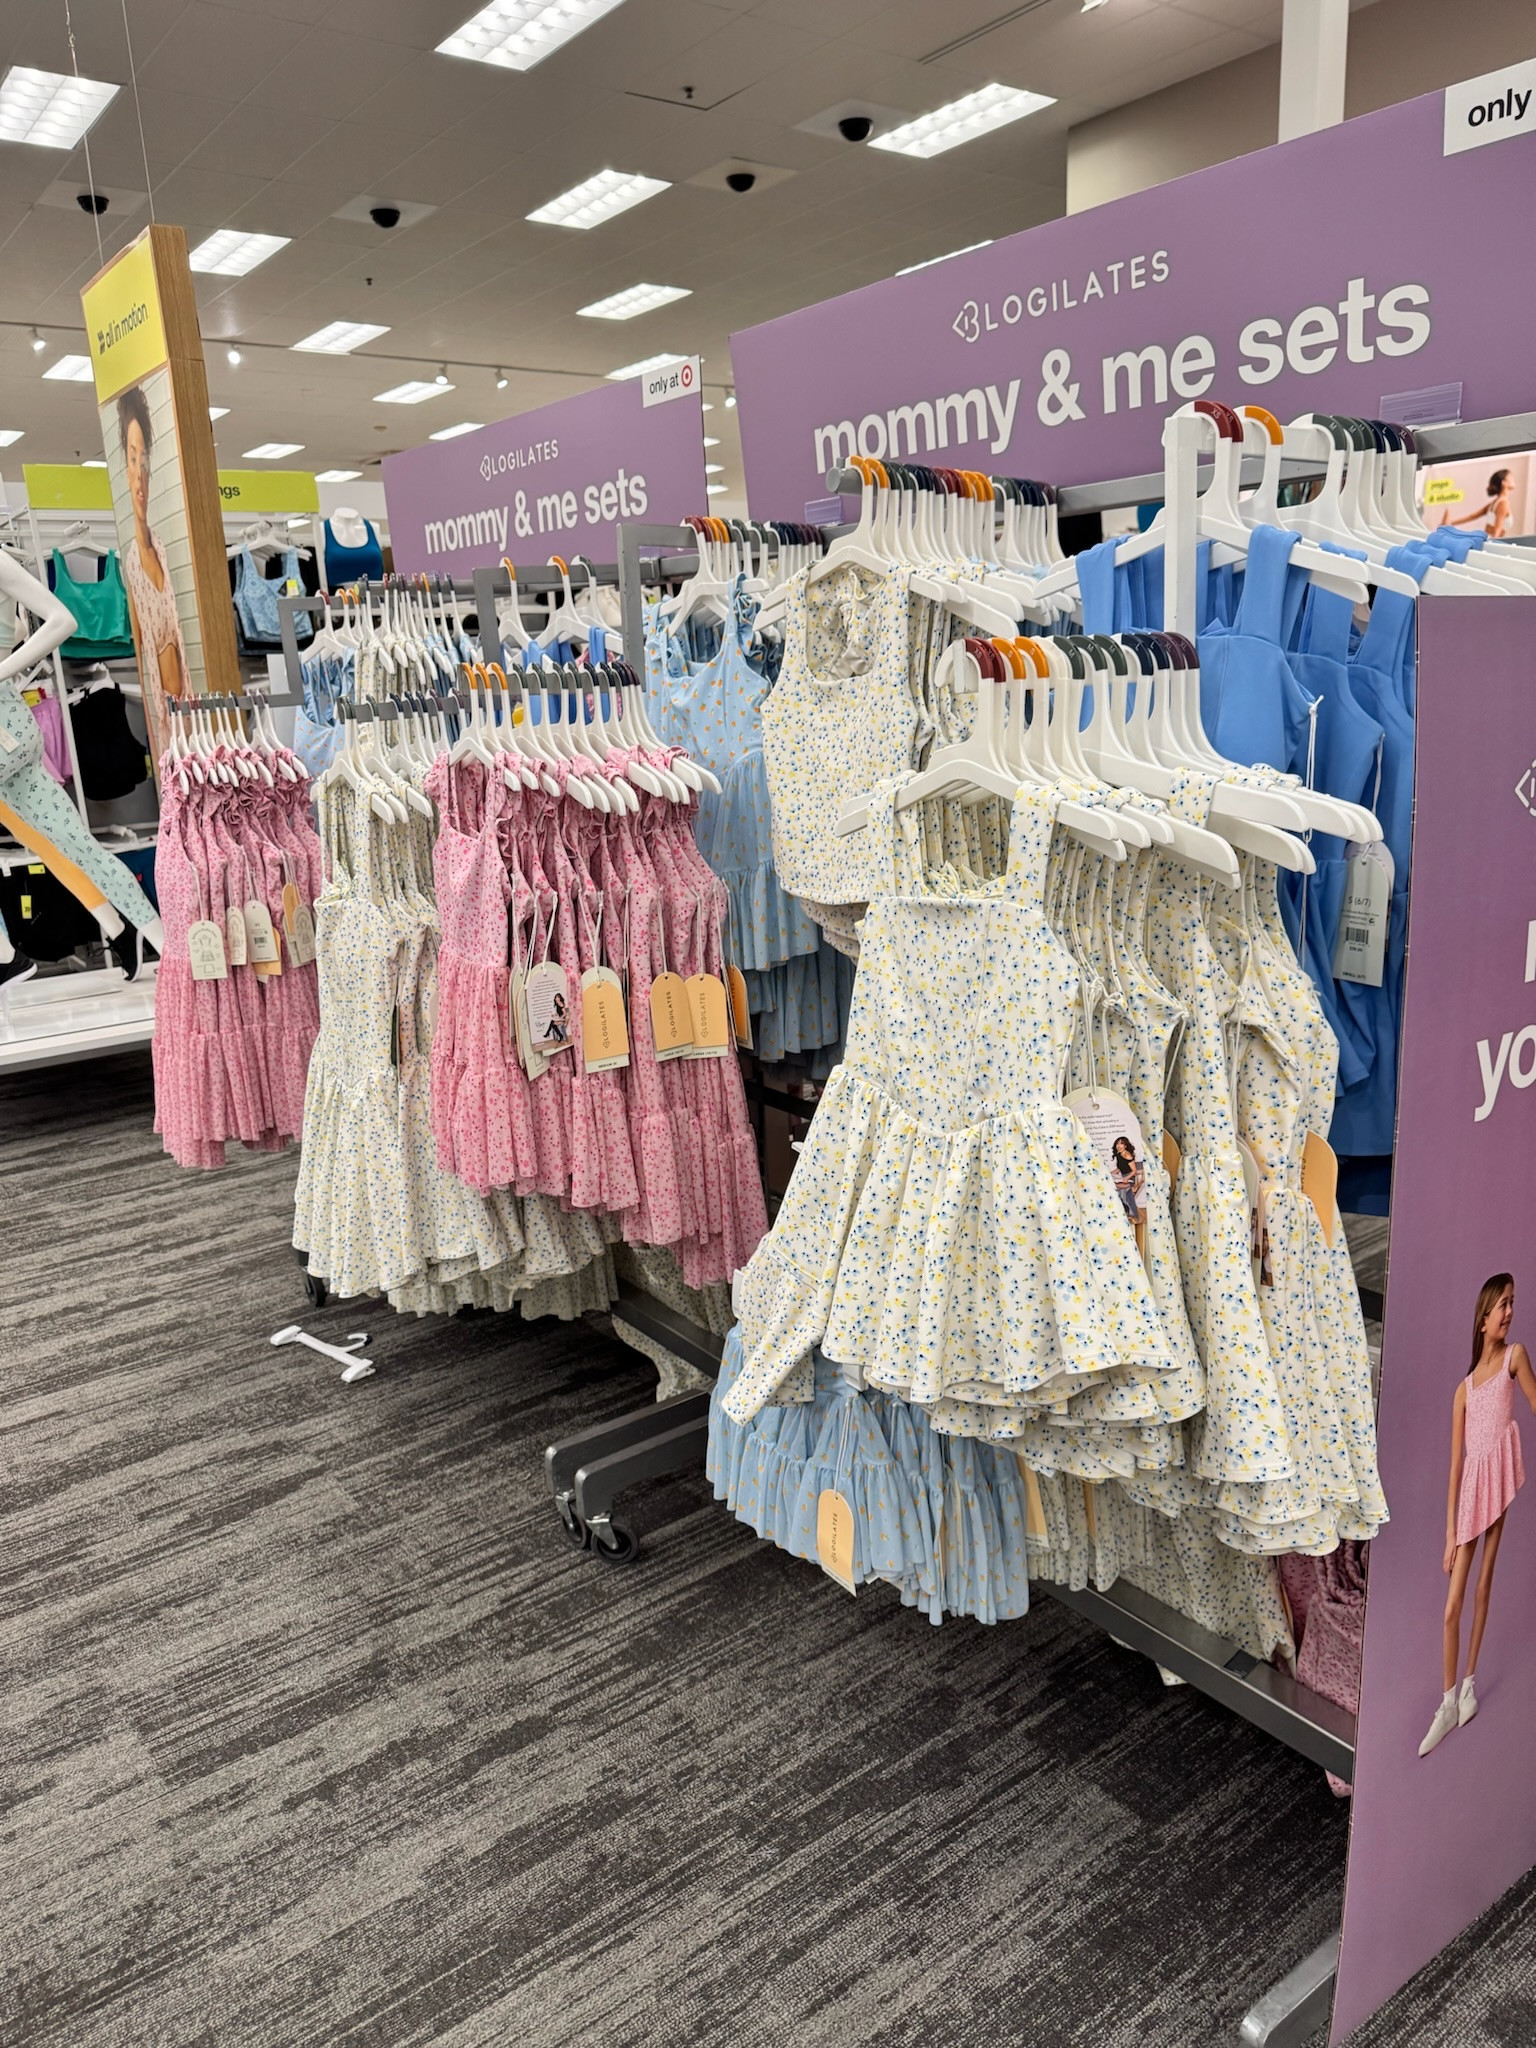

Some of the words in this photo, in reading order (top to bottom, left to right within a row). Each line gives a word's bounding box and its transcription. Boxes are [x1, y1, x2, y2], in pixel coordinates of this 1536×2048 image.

[1467, 87, 1533, 128] only
[105, 322, 115, 349] all
[113, 319, 122, 343] in
[121, 302, 149, 337] motion
[649, 377, 669, 395] only
[669, 372, 680, 389] at
[813, 378, 1021, 474] mommy
[1036, 348, 1087, 427] &
[1102, 334, 1216, 415] me
[1238, 277, 1431, 385] sets
[1329, 422, 1338, 431] M
[424, 505, 509, 555] mommy
[514, 489, 534, 538] &
[536, 490, 579, 534] me
[583, 468, 649, 525] sets
